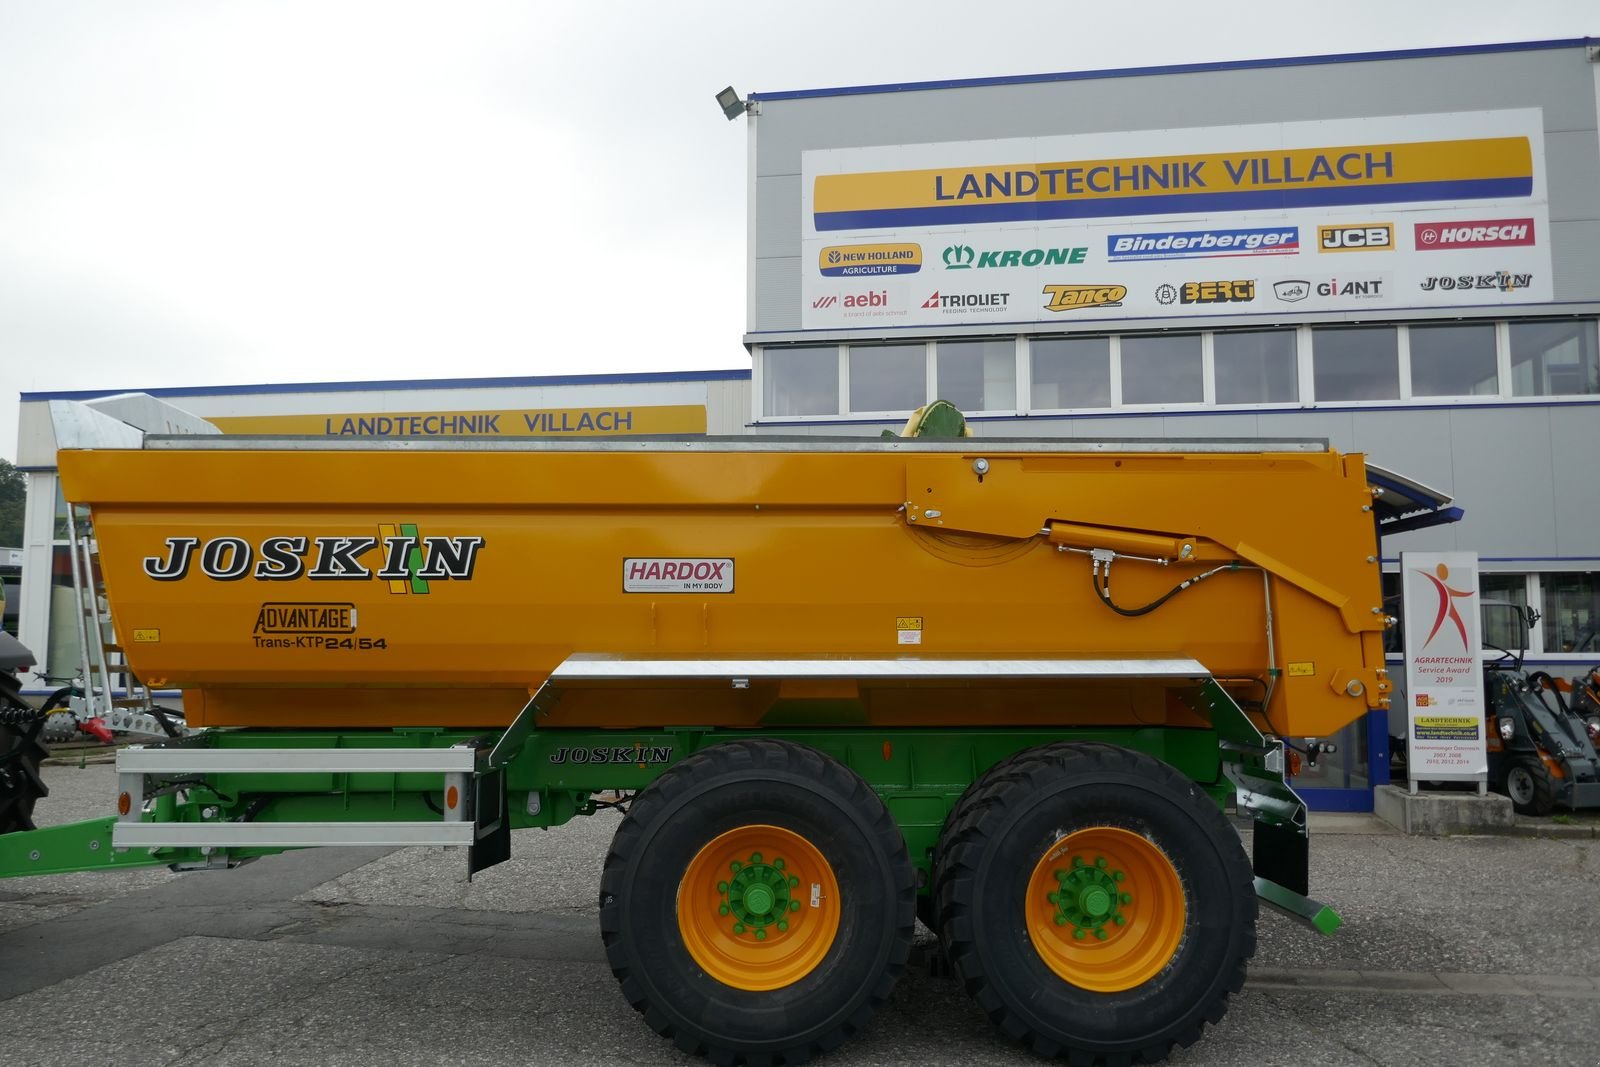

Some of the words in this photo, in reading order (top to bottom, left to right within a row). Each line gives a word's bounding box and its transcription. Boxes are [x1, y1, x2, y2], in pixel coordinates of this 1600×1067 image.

[936, 161, 1206, 200] LANDTECHNIK
[1223, 151, 1394, 186] VILLACH
[1113, 232, 1294, 252] Binderberger
[1323, 228, 1389, 248] JCB
[1440, 225, 1528, 243] HORSCH
[843, 253, 866, 262] NEW
[868, 250, 914, 261] HOLLAND
[977, 247, 1089, 269] KRONE
[842, 265, 897, 275] AGRICULTURE
[1420, 273, 1533, 290] JOSKIN
[843, 290, 887, 308] aebi
[940, 293, 1010, 308] TRIOLIET
[1043, 285, 1127, 308] Tanco
[326, 414, 501, 436] LANDTECHNIK
[523, 411, 632, 432] VILLACH
[142, 535, 486, 581] JOSKIN
[629, 562, 726, 580] HARDOX
[253, 608, 349, 633] ADVANTAGE
[1414, 656, 1473, 664] AGRARTECHNIK
[1417, 666, 1445, 674] Service
[1446, 666, 1470, 674] Award
[550, 746, 673, 764] JOSKIN
